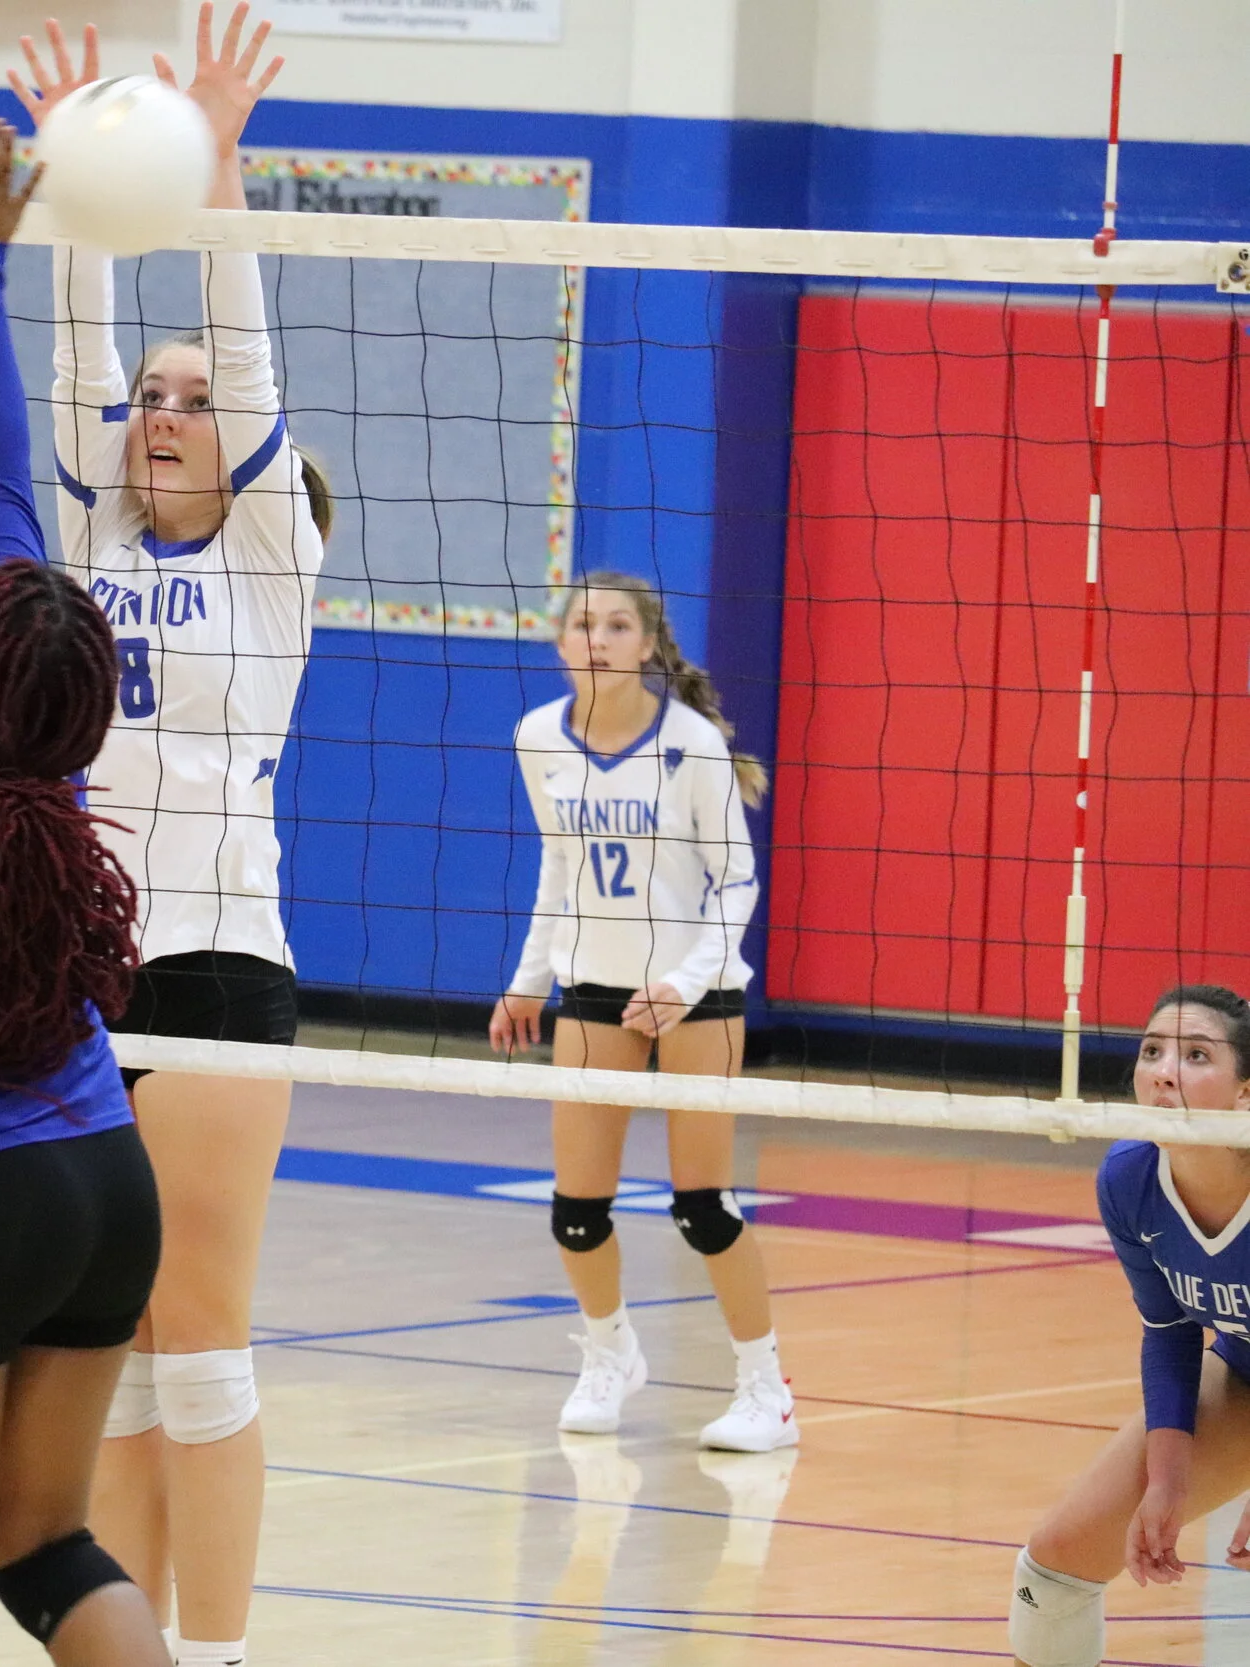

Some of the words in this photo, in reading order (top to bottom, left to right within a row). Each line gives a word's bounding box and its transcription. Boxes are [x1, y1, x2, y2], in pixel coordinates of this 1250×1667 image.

[114, 636, 156, 719] 8
[556, 799, 659, 835] STANTON
[590, 842, 635, 897] 12
